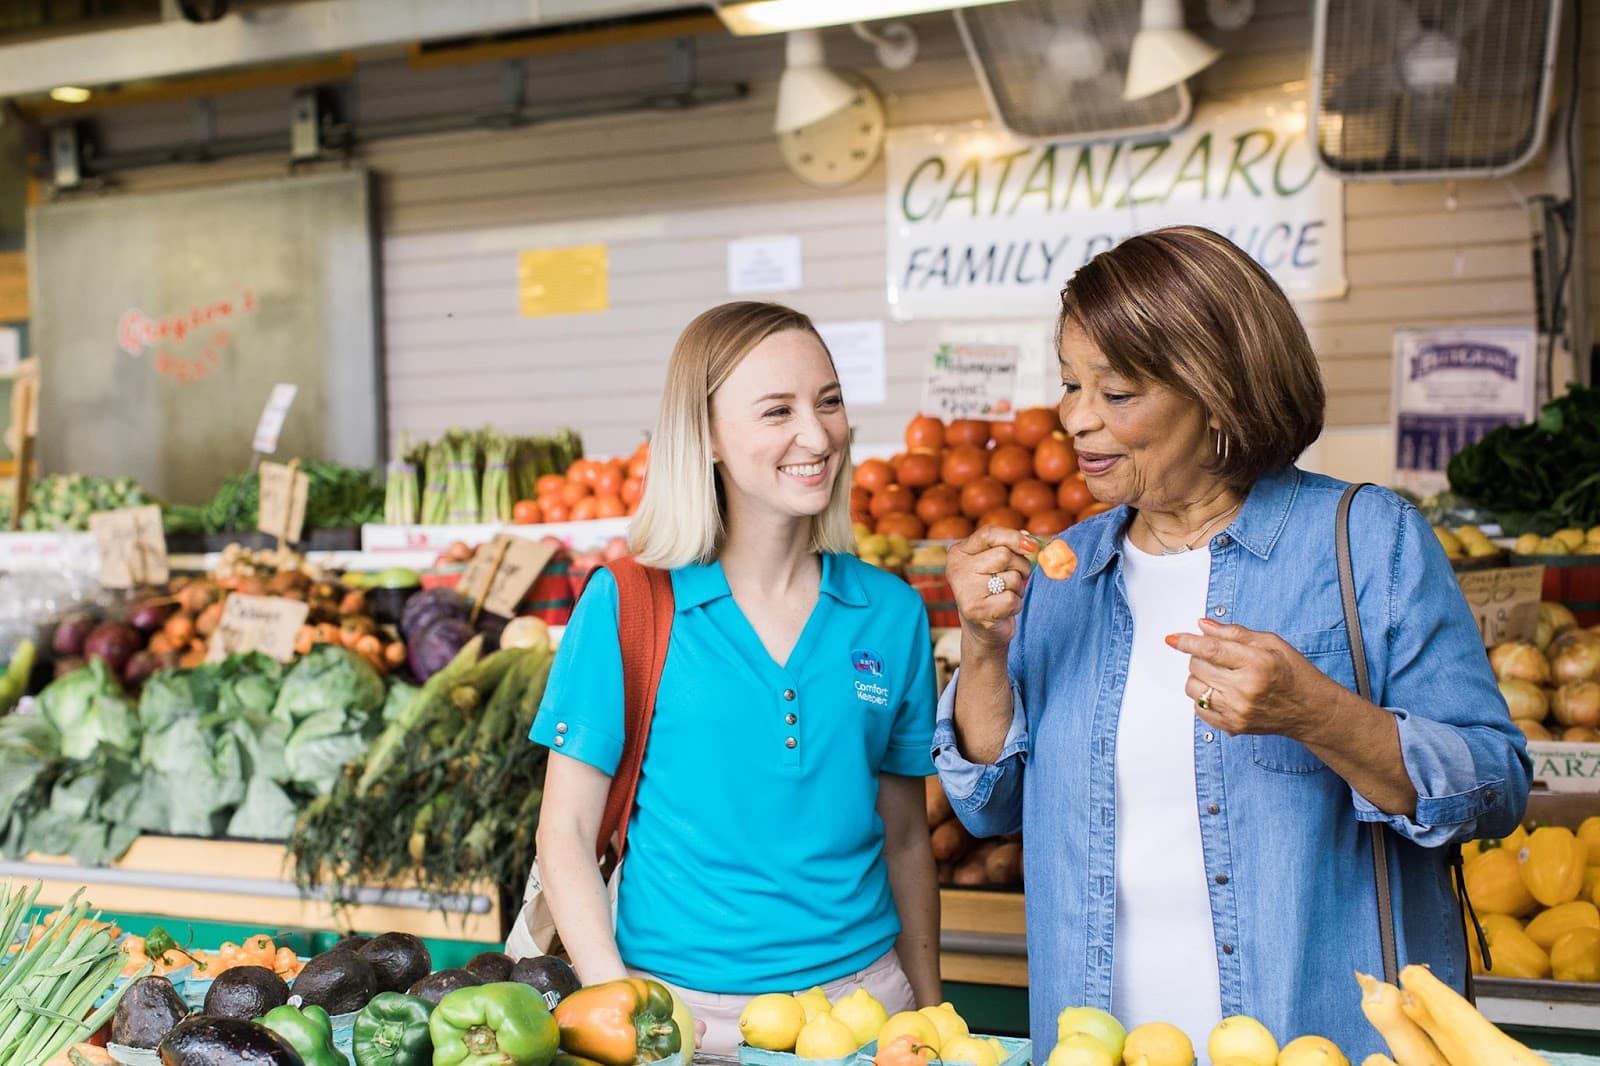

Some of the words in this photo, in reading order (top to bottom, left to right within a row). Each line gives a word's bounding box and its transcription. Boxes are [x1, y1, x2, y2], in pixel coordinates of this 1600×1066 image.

[901, 128, 1319, 223] CATANZARO
[903, 233, 1072, 289] FAMILY
[1081, 219, 1326, 269] PUCE
[854, 680, 888, 697] Comfort
